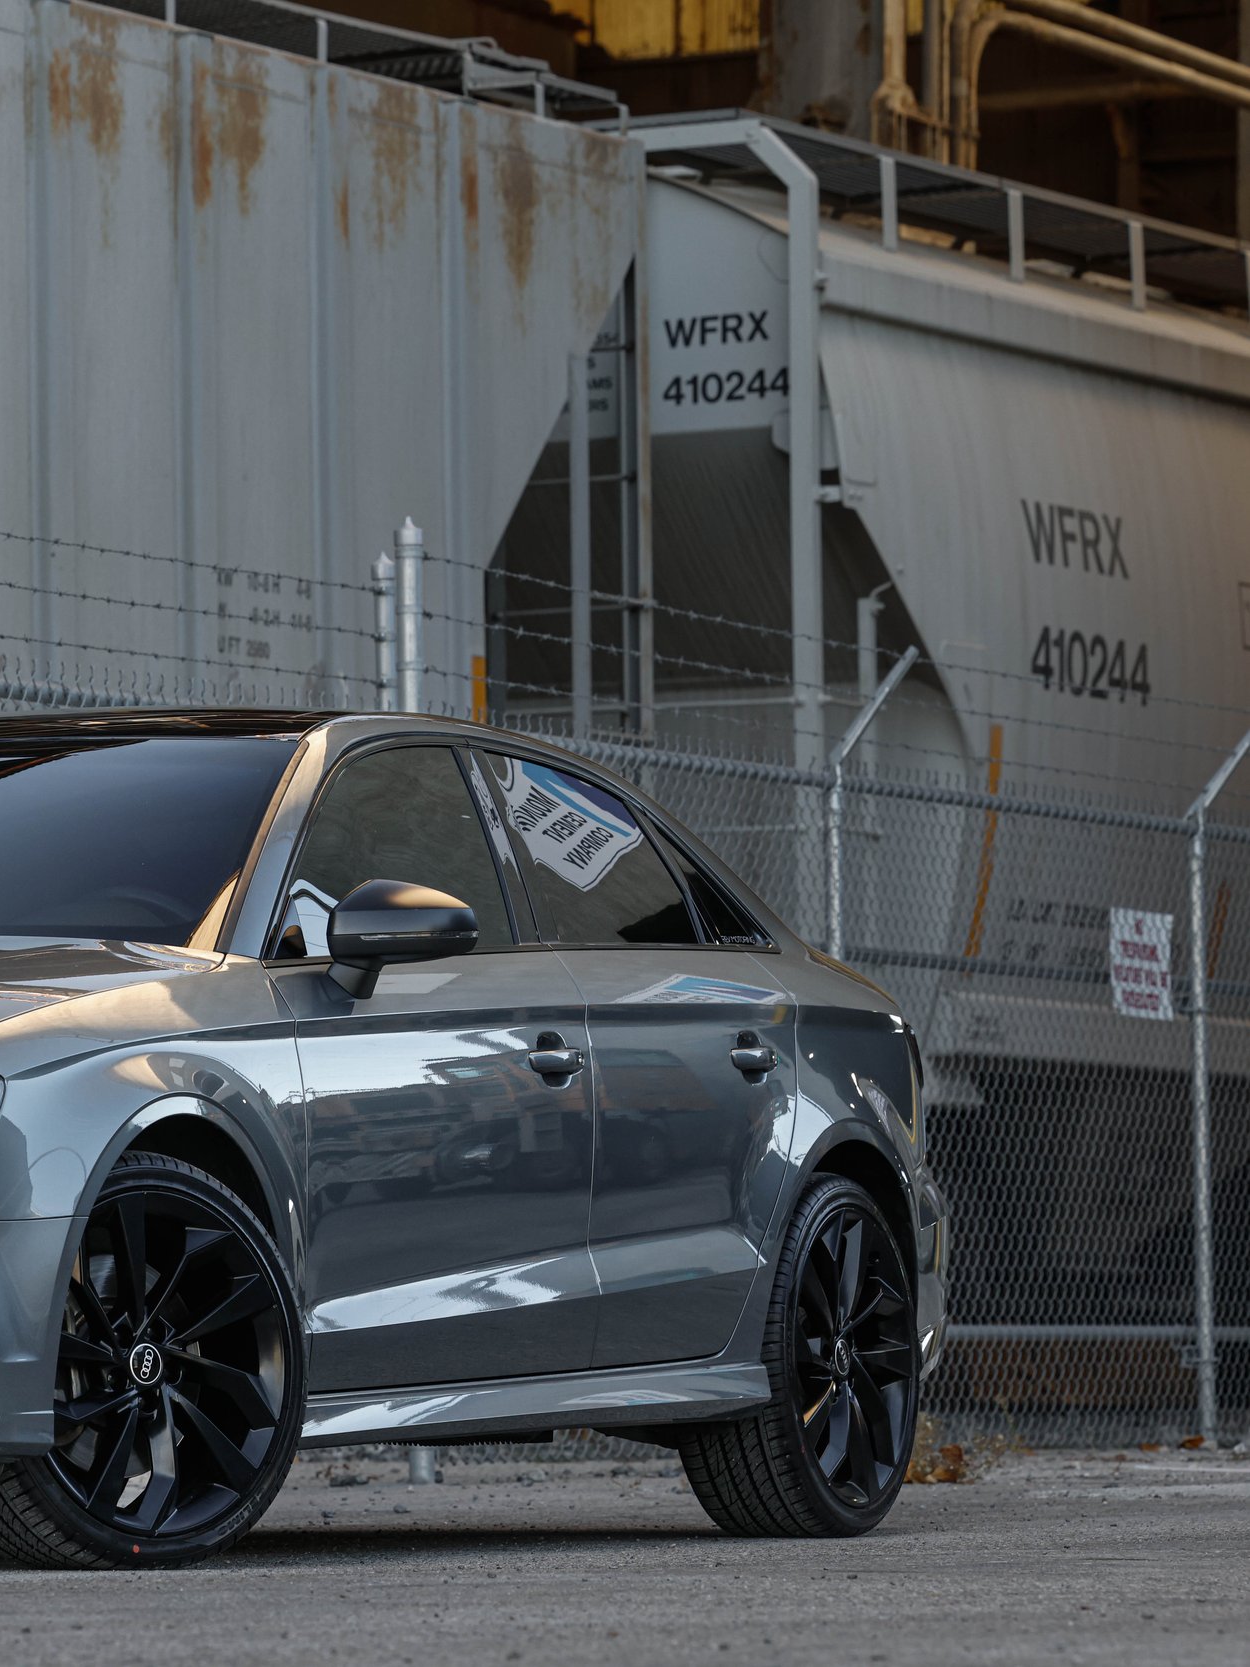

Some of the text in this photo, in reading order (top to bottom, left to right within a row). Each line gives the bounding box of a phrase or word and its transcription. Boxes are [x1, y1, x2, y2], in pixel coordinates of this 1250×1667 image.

[664, 310, 769, 348] WFRX
[662, 366, 790, 406] 410244
[1020, 498, 1130, 580] WFRX
[1030, 625, 1151, 707] 410244
